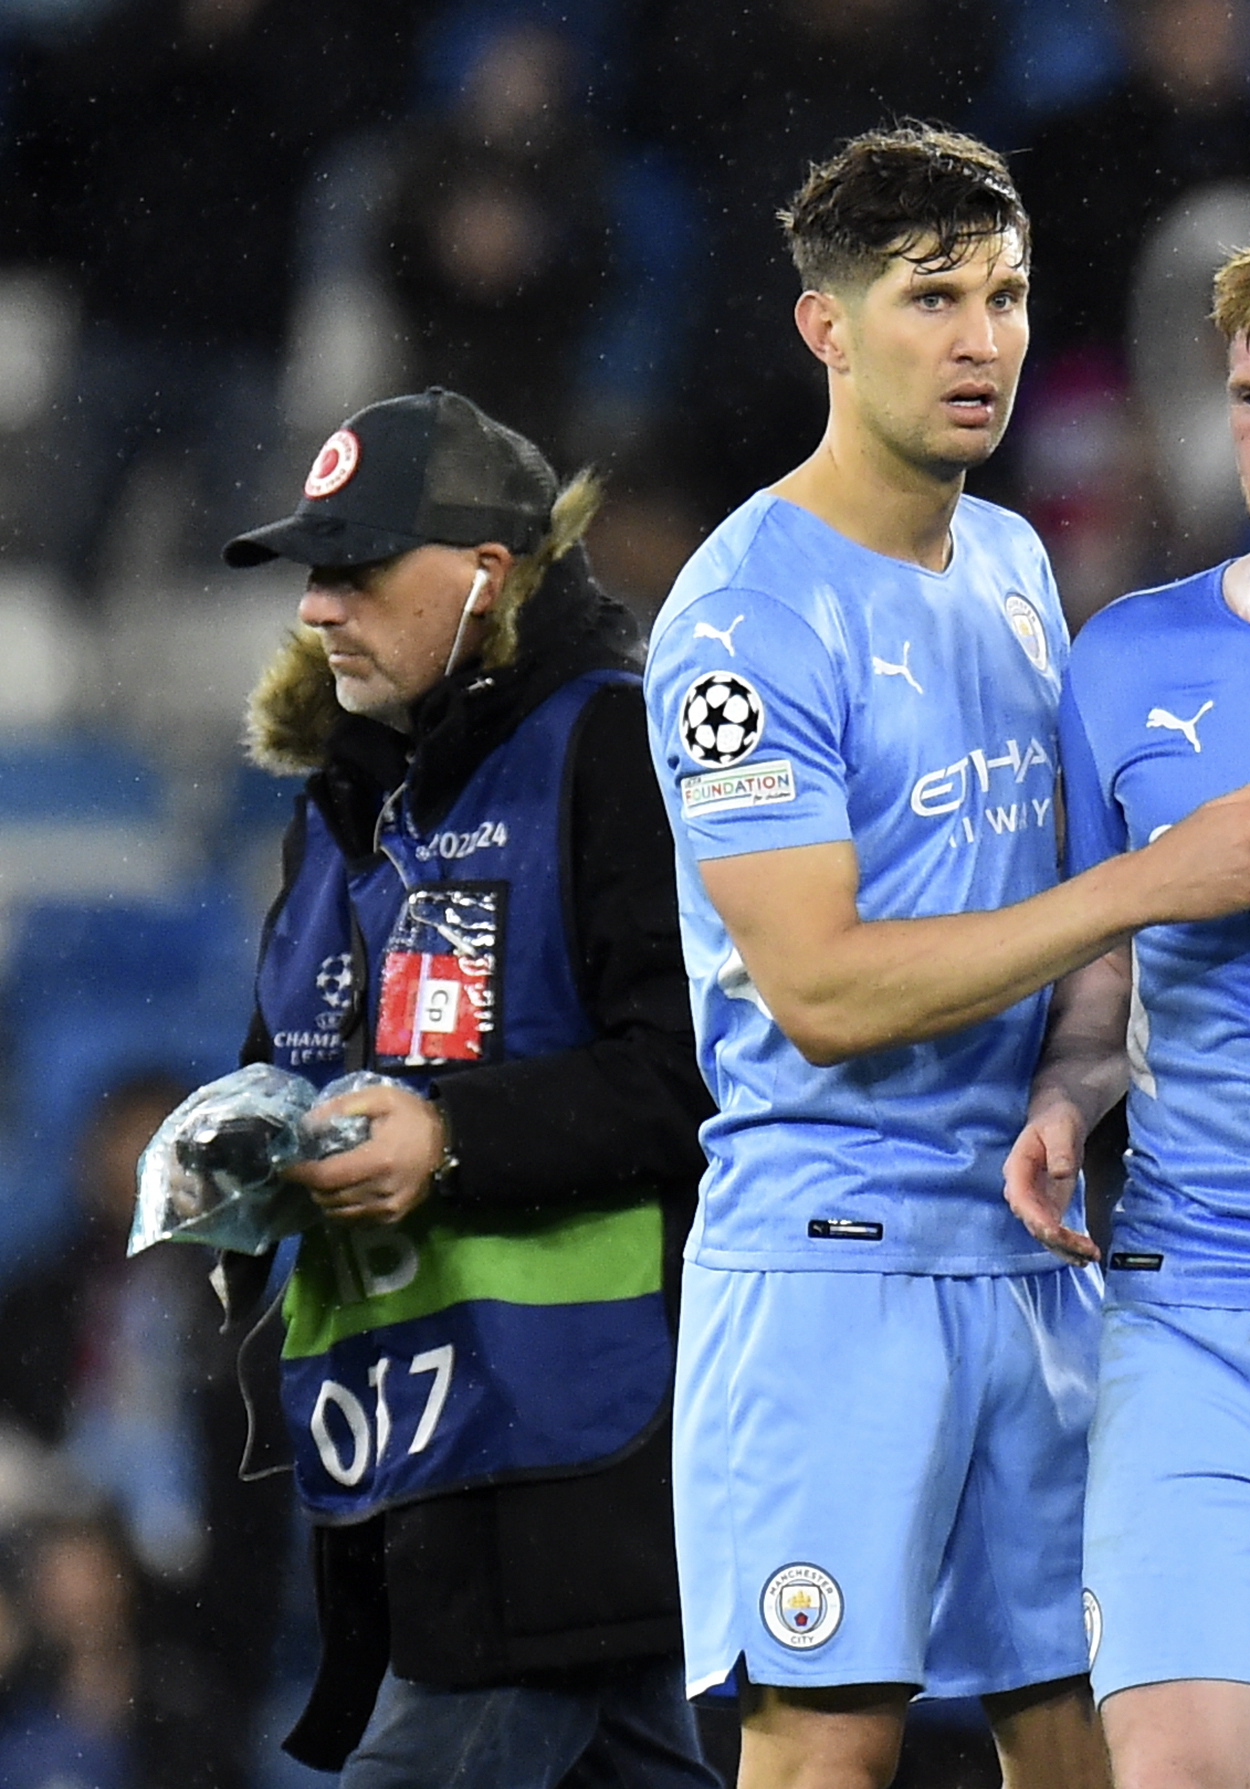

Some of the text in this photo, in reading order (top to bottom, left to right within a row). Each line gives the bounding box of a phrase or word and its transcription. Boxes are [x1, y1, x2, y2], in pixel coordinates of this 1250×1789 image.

[684, 773, 790, 803] FOUNDATION
[769, 1569, 834, 1597] MANCHESTER
[790, 1635, 815, 1645] CITY
